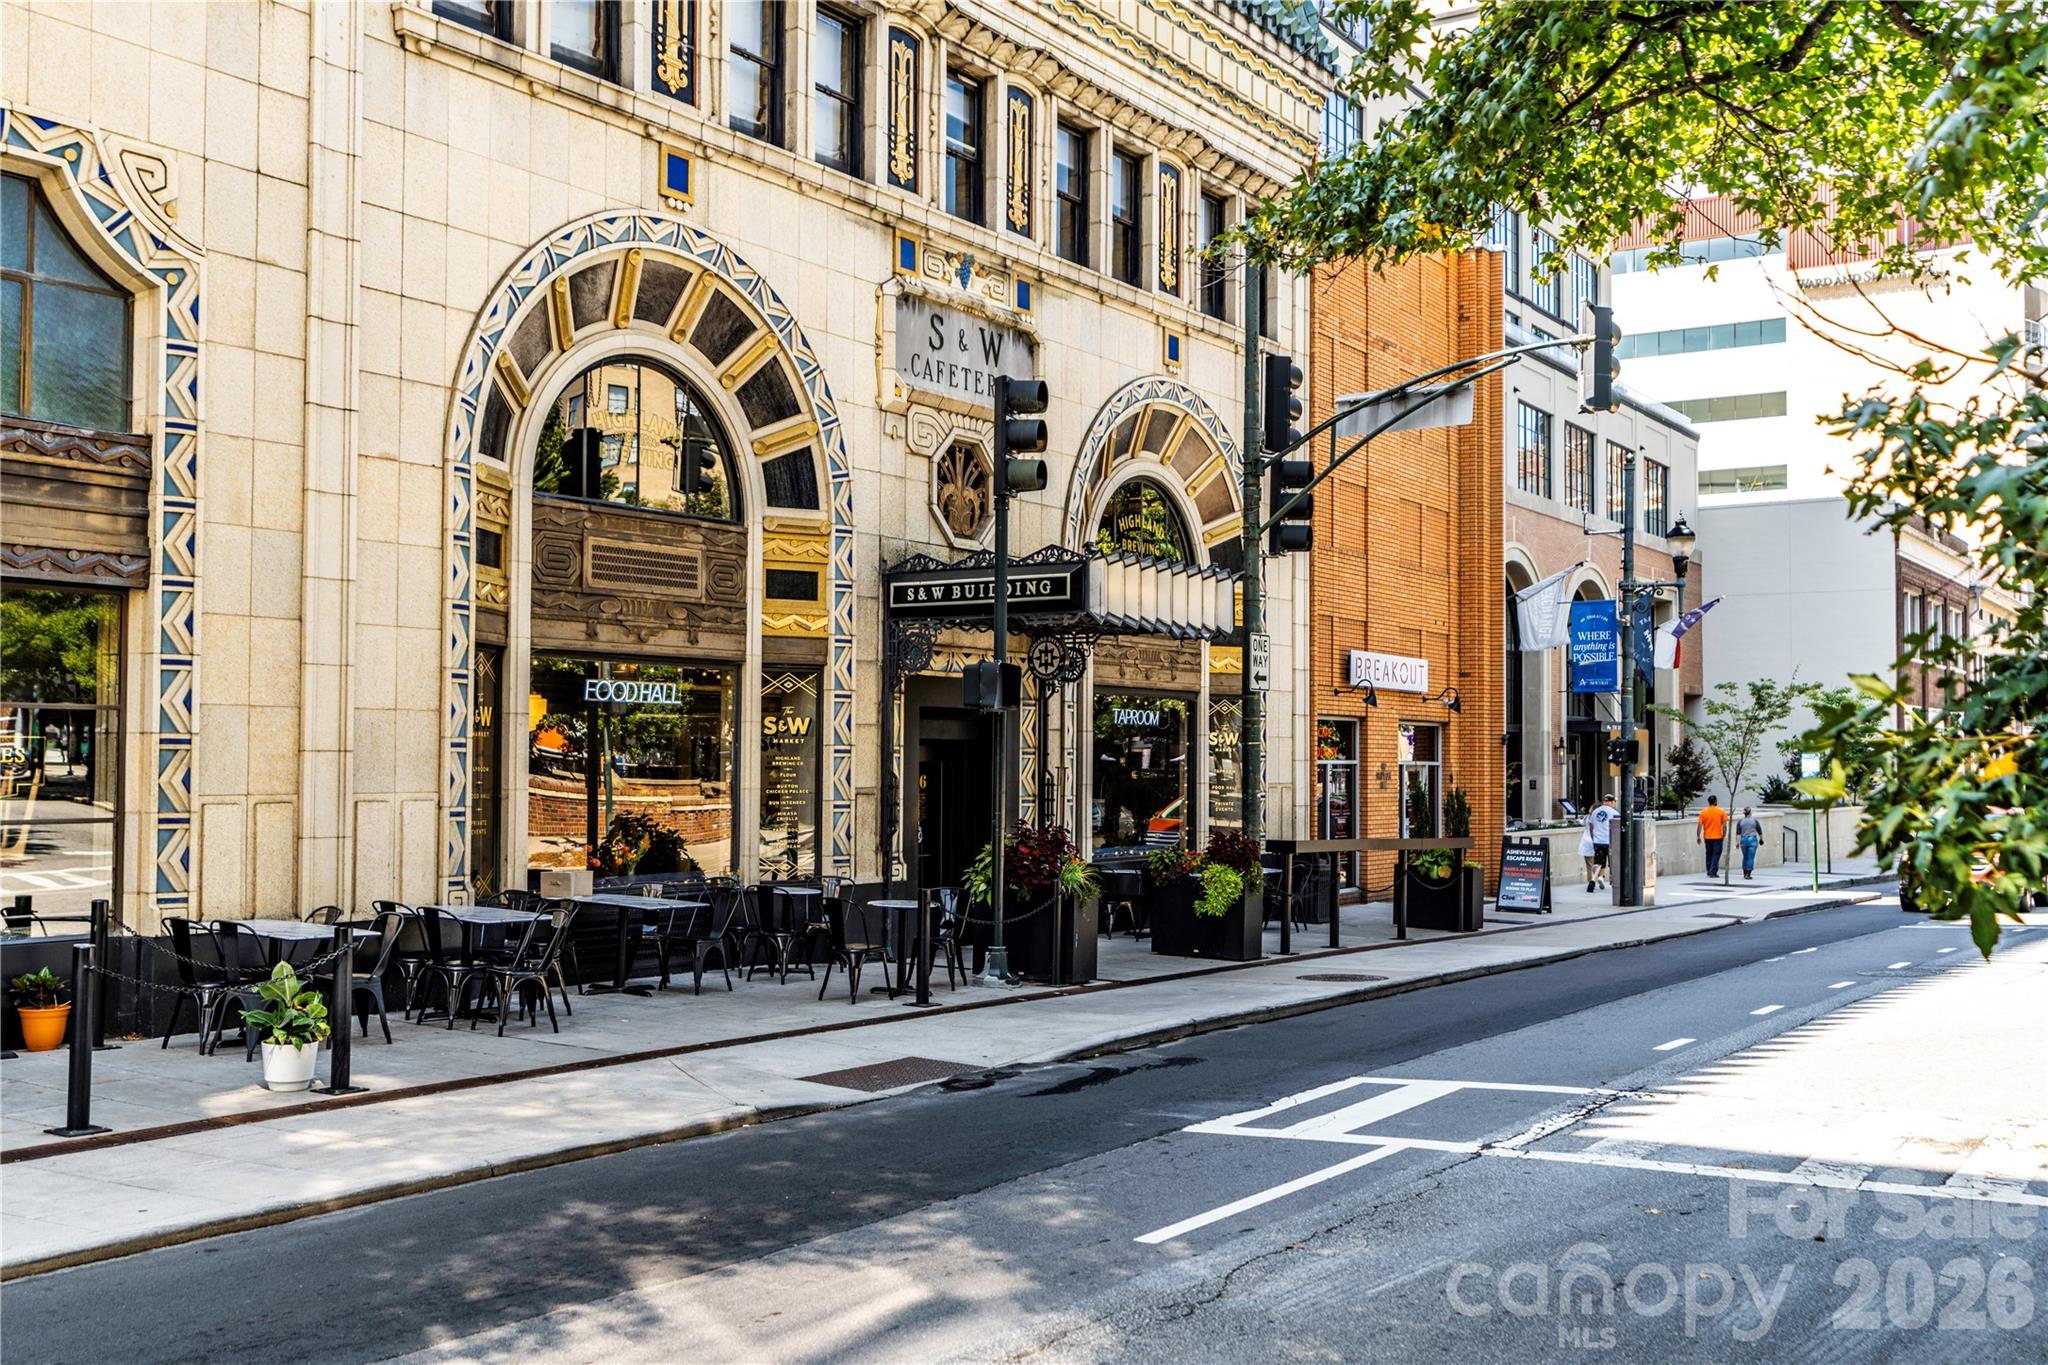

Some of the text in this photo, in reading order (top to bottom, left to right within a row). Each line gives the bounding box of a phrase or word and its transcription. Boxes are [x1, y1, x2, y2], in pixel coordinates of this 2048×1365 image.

[929, 313, 1004, 368] S & W
[911, 353, 996, 398] CAFETER
[1119, 513, 1165, 540] HIGHLAND
[1122, 538, 1161, 557] BREWING
[907, 586, 944, 601] S&W
[1578, 630, 1612, 641] WHERE
[1253, 639, 1268, 653] ONE
[1573, 641, 1616, 652] anything is
[1253, 655, 1269, 669] WAY
[1355, 656, 1425, 686] BREAKOUT
[584, 679, 682, 704] FOOD HALL
[782, 706, 795, 716] The
[1112, 708, 1160, 726] TAPROOM
[763, 716, 811, 736] S&W
[1208, 732, 1239, 746] S&W
